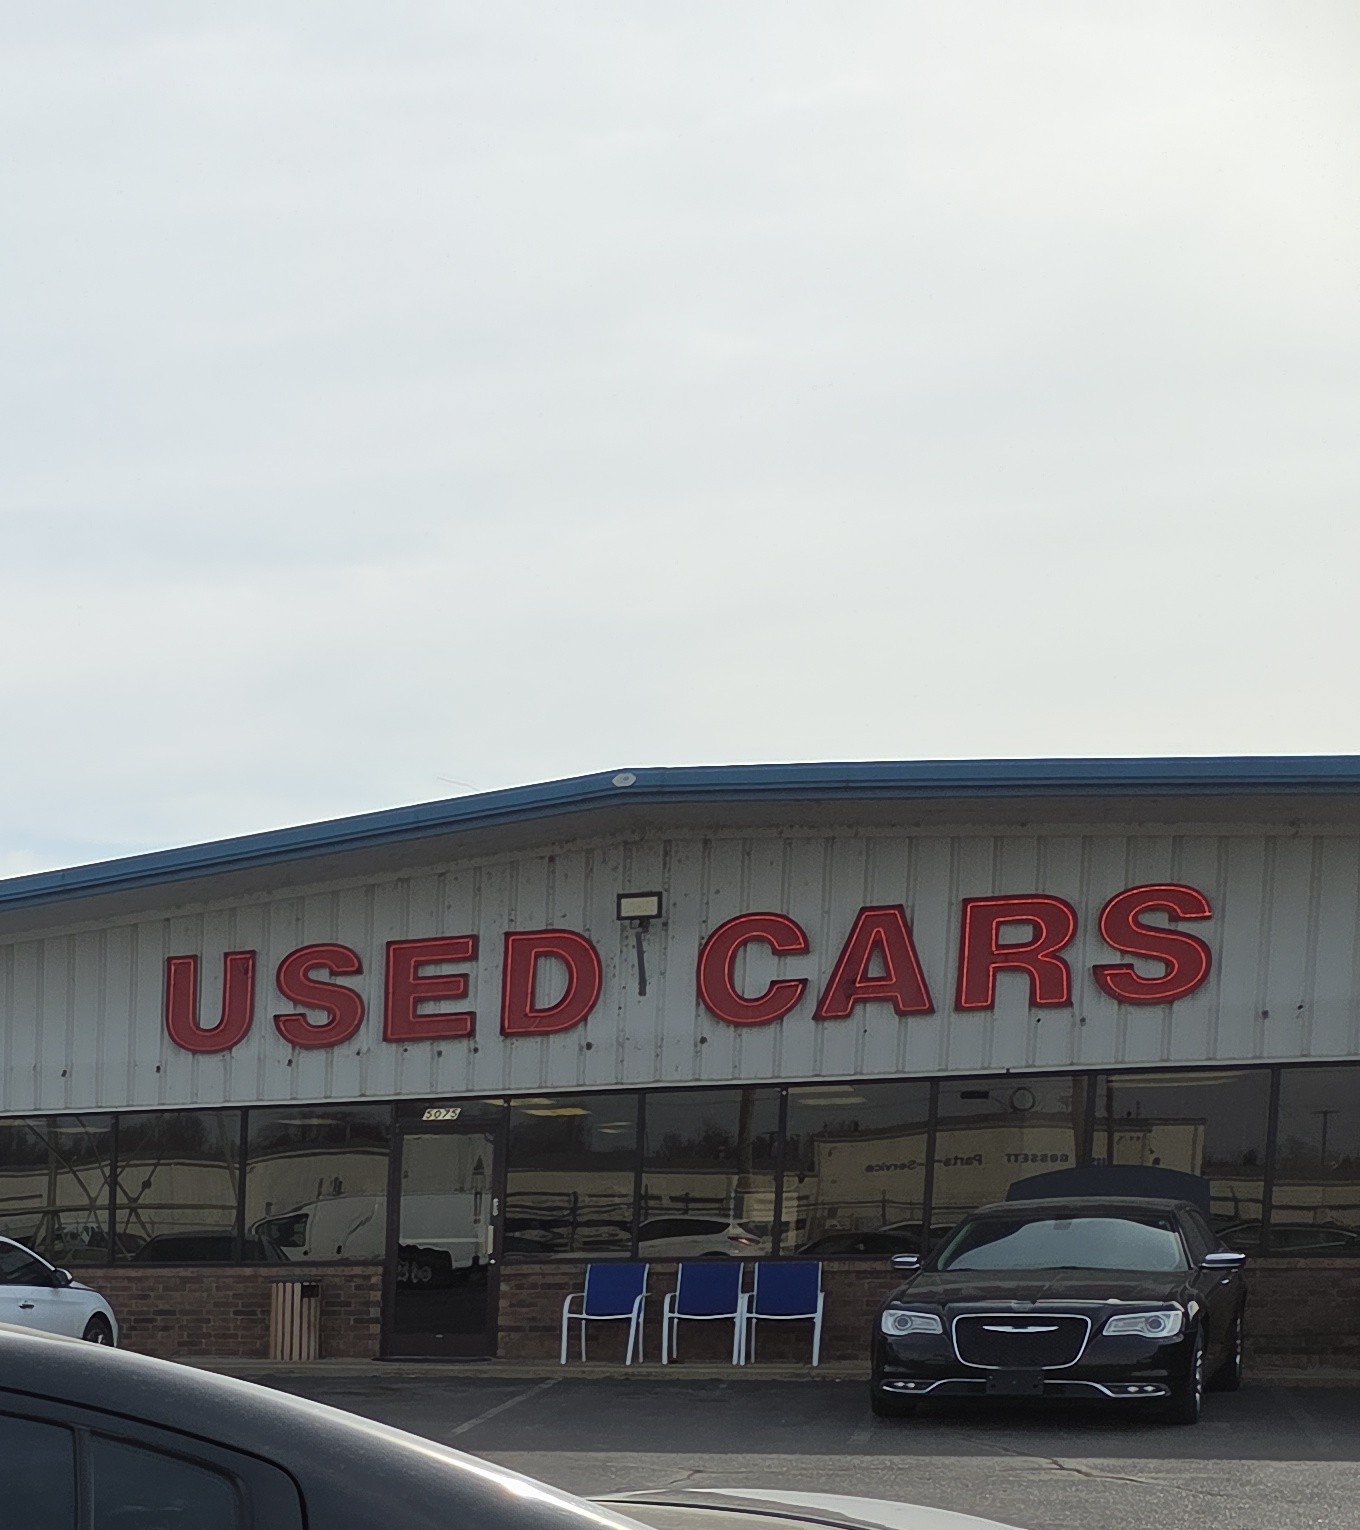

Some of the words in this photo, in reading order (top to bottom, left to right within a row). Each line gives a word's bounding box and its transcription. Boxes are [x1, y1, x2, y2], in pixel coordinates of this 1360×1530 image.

[165, 929, 603, 1053] USED
[696, 883, 1214, 1027] CARS
[425, 1107, 459, 1120] 5075
